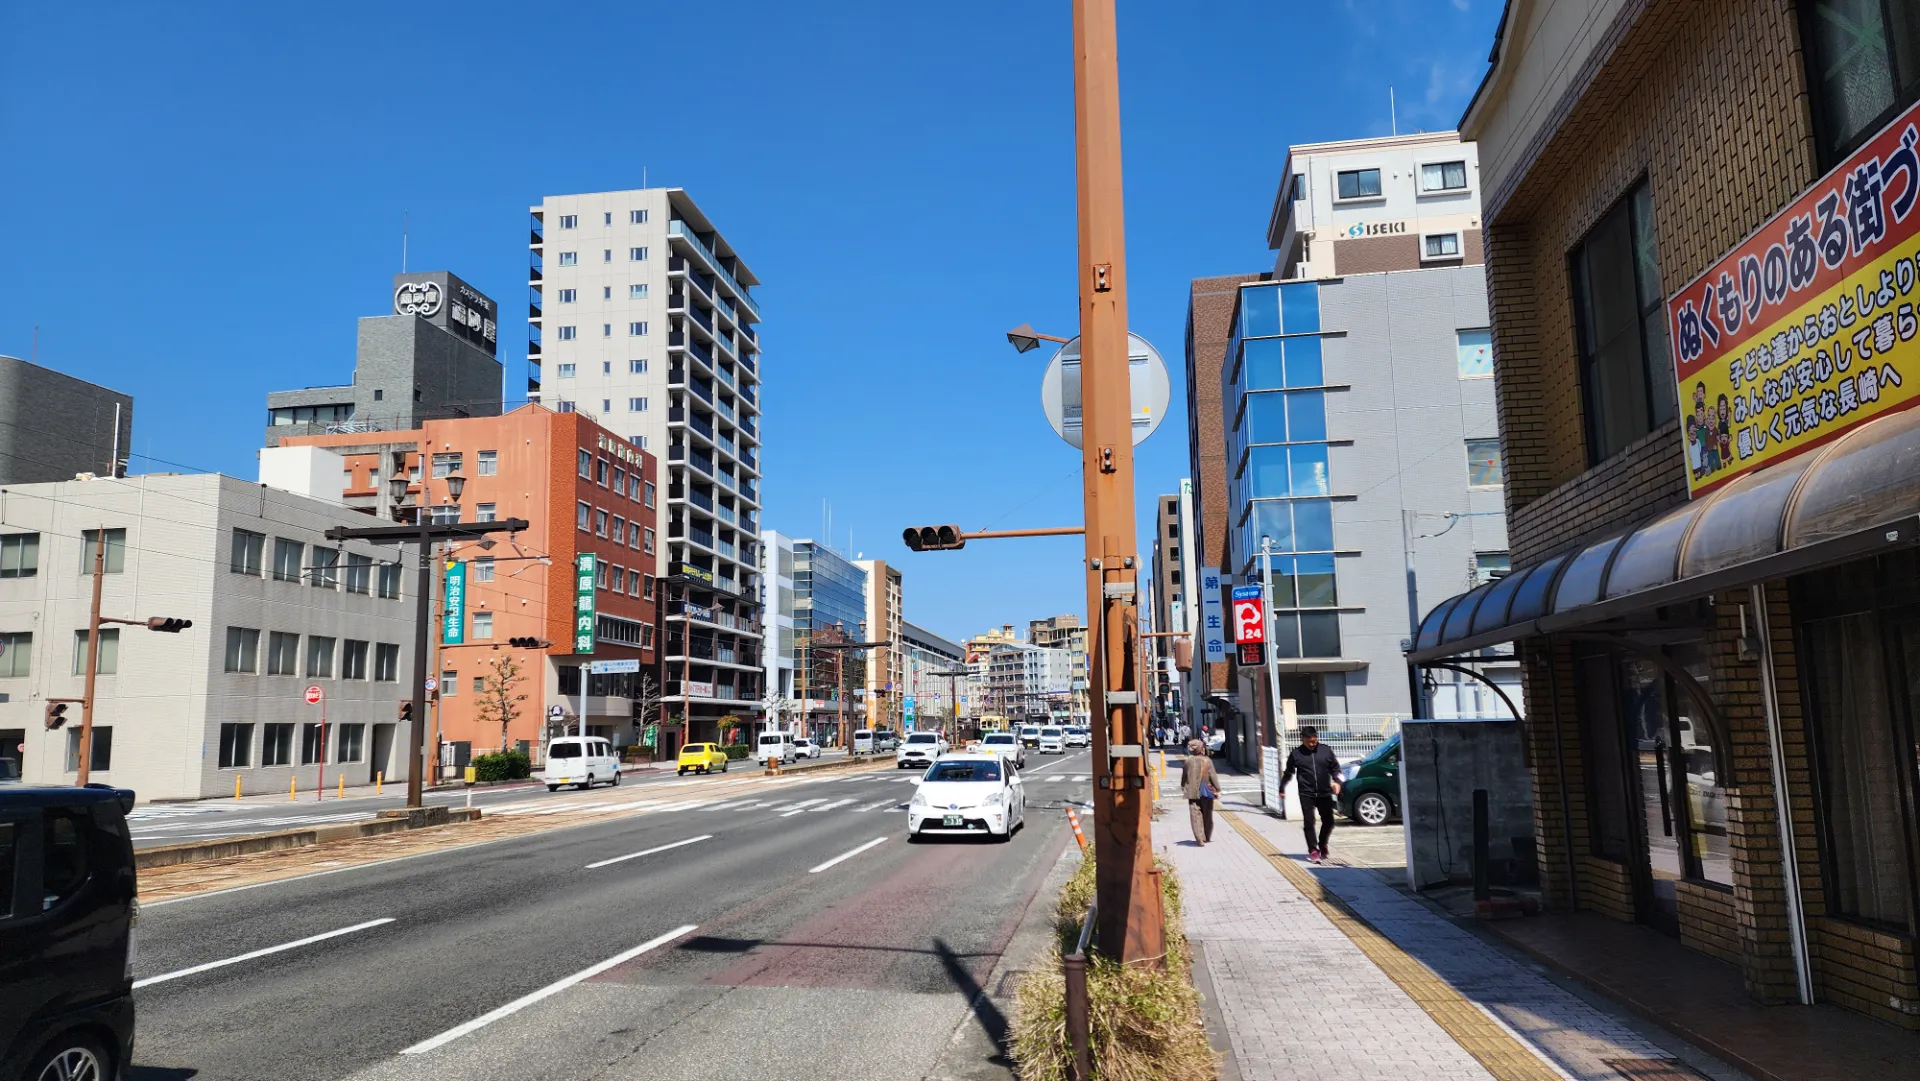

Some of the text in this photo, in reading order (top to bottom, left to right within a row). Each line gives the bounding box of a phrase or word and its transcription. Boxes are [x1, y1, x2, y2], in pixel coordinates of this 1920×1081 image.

[1366, 221, 1405, 236] ISEKI
[1678, 123, 1920, 363] ぬくもりのある街づ
[1733, 302, 1920, 424] みんなが安心して暮ら
[1736, 362, 1903, 460] 優しく元気な長崎へ
[447, 575, 462, 638] 明治安田生命
[1205, 576, 1222, 653] 第一生命
[1234, 590, 1259, 598] System
[1245, 628, 1263, 639] 24
